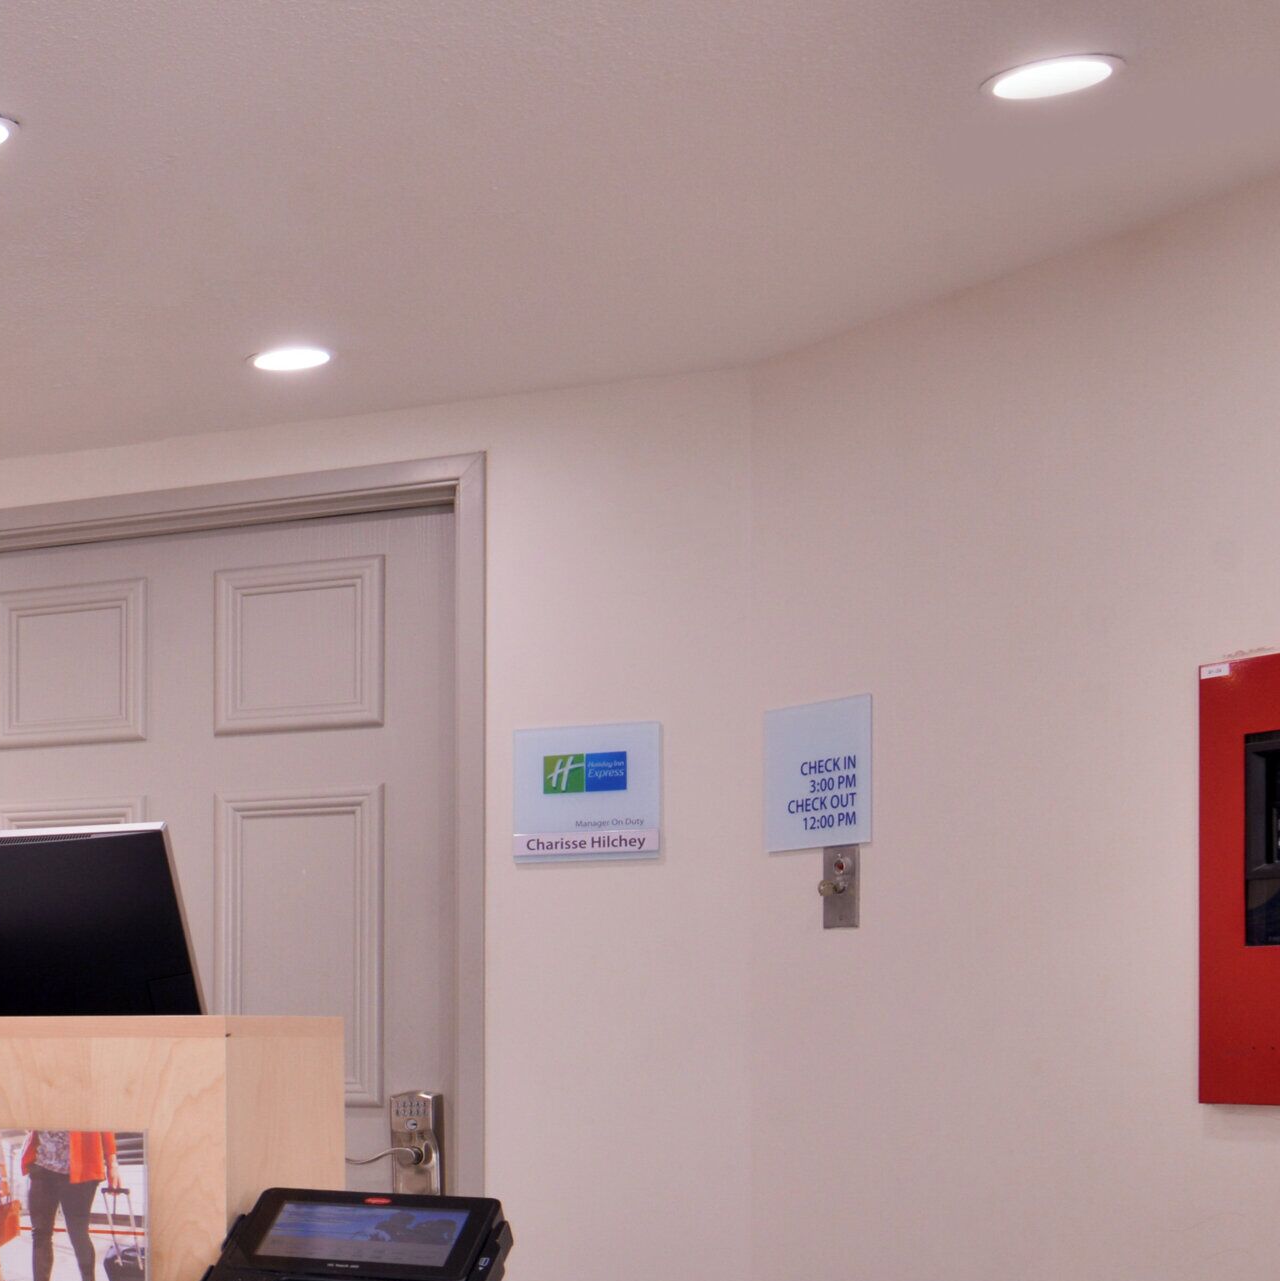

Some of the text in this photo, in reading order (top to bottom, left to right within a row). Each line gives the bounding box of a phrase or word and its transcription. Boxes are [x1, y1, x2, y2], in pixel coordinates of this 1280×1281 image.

[587, 768, 625, 778] Express
[800, 754, 857, 776] CHECK IN
[809, 773, 857, 793] 3:00 PM
[787, 792, 857, 814] CHECK OUT
[575, 817, 644, 829] Manager On Duty
[803, 811, 857, 830] 12:00 PM
[526, 835, 646, 851] Charisse Hilchey
